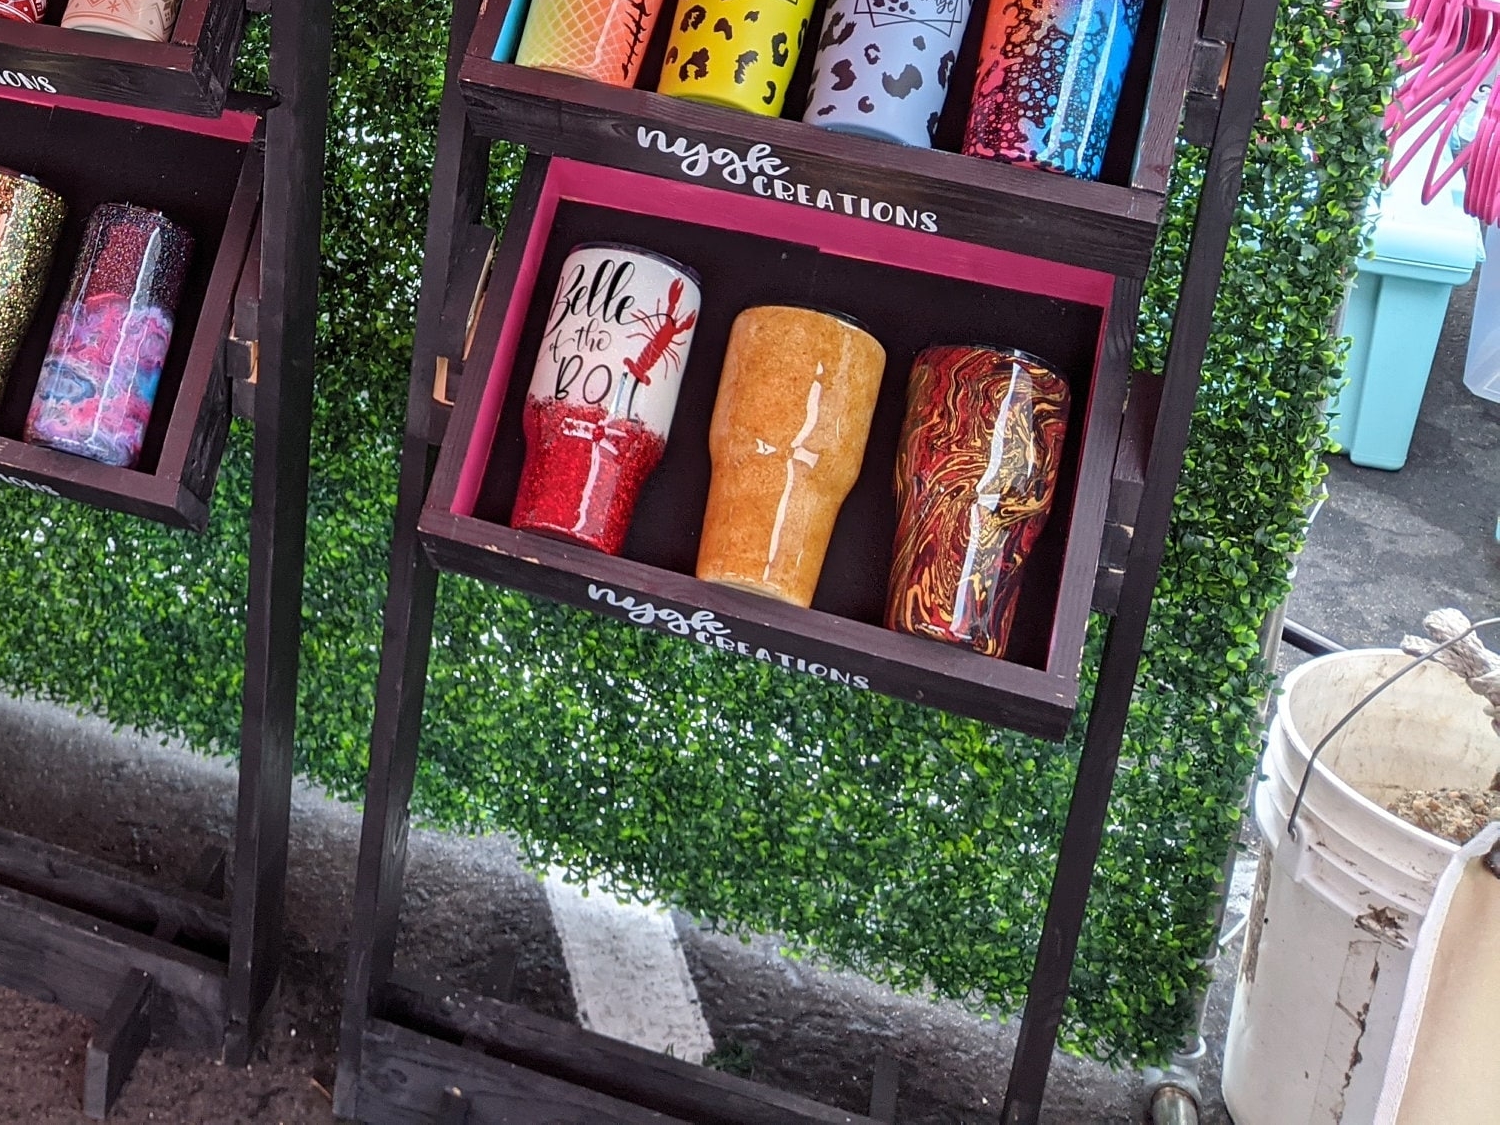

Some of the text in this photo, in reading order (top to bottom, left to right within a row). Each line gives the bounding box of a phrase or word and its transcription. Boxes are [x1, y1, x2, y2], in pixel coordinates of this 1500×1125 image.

[637, 126, 790, 184] nygk
[752, 175, 939, 233] CREATIONS
[543, 259, 676, 339] Belle
[575, 318, 612, 352] the
[587, 583, 732, 635] nygk
[695, 631, 870, 691] CREATIONS
